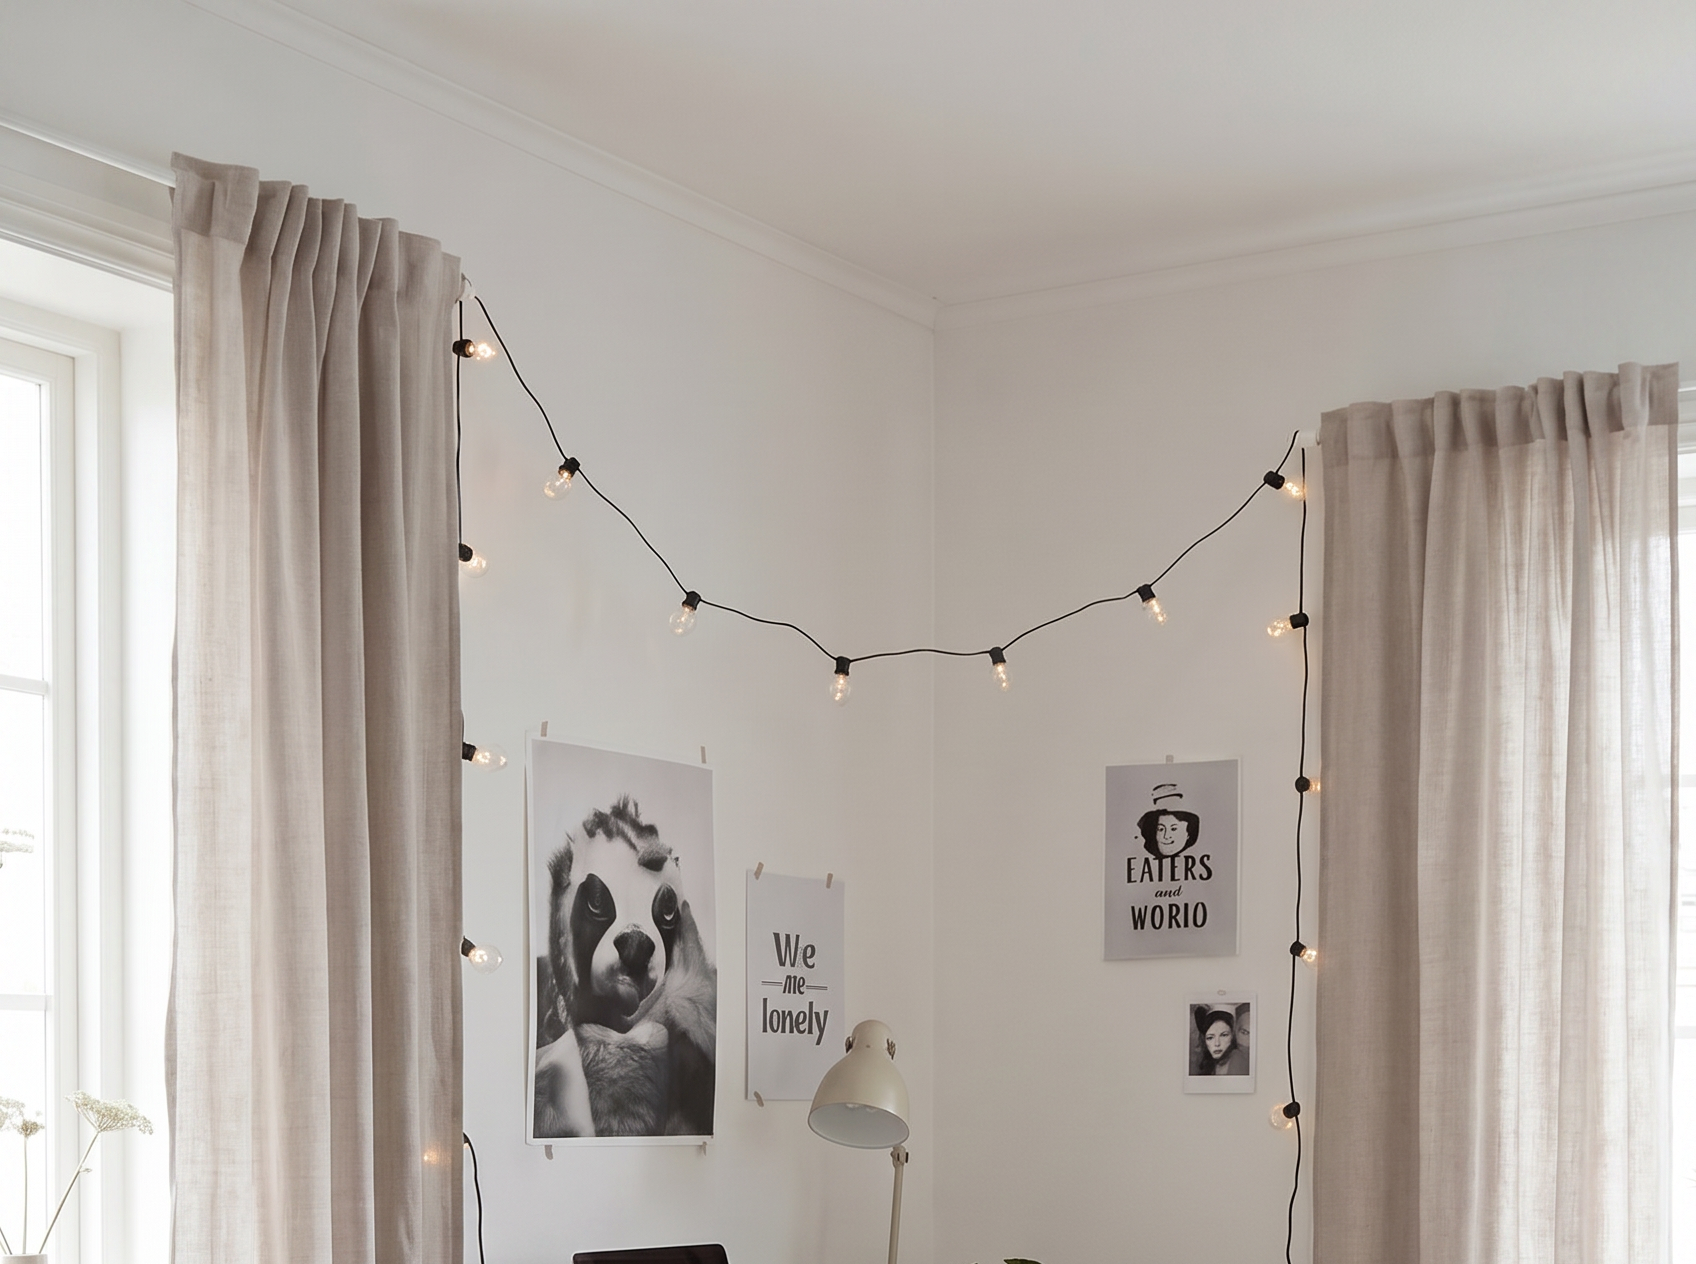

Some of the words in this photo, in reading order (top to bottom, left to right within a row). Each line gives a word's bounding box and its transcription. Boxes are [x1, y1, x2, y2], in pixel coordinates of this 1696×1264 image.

[1126, 853, 1213, 884] EATERS
[1154, 885, 1183, 898] and
[1131, 901, 1208, 931] WORIO
[772, 931, 816, 969] We
[761, 997, 829, 1046] lonely
